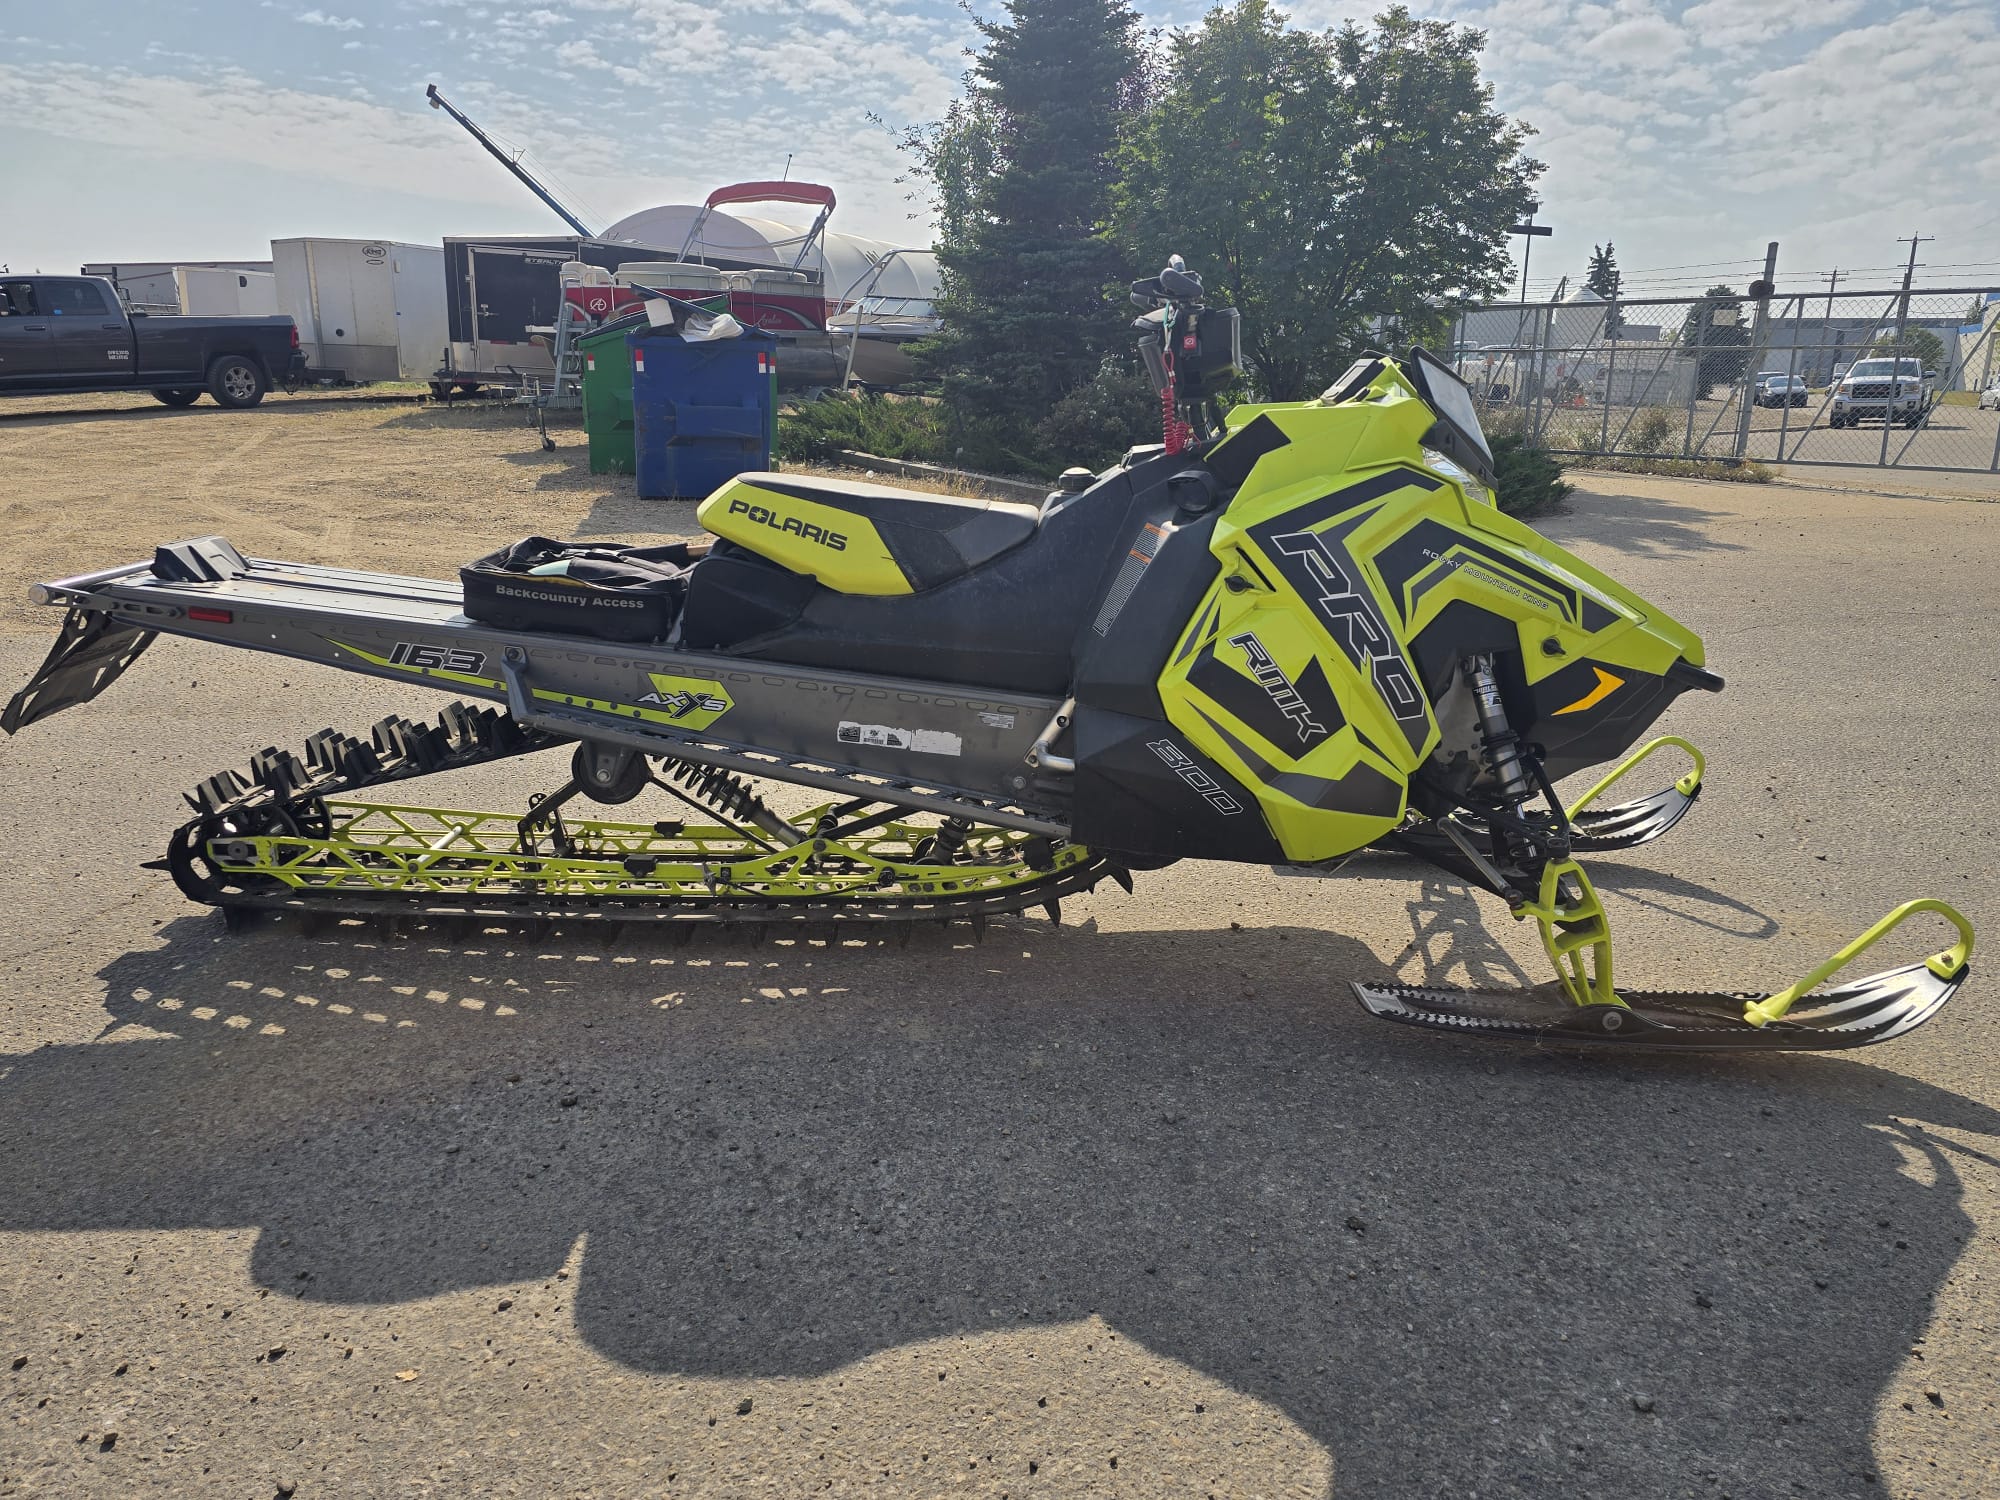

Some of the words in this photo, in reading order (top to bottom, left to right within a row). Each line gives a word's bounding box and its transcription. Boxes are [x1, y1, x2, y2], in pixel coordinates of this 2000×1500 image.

[728, 499, 848, 552] POLARIS
[495, 584, 587, 607] Backcountry
[592, 597, 645, 609] Access
[1422, 548, 1462, 569] ROCKY
[1463, 566, 1521, 597] MOUNTAIN
[1522, 592, 1550, 610] KING
[1271, 531, 1426, 721] PRO
[388, 641, 488, 675] 163
[1227, 630, 1328, 743] RMK
[1145, 738, 1244, 816] 800
